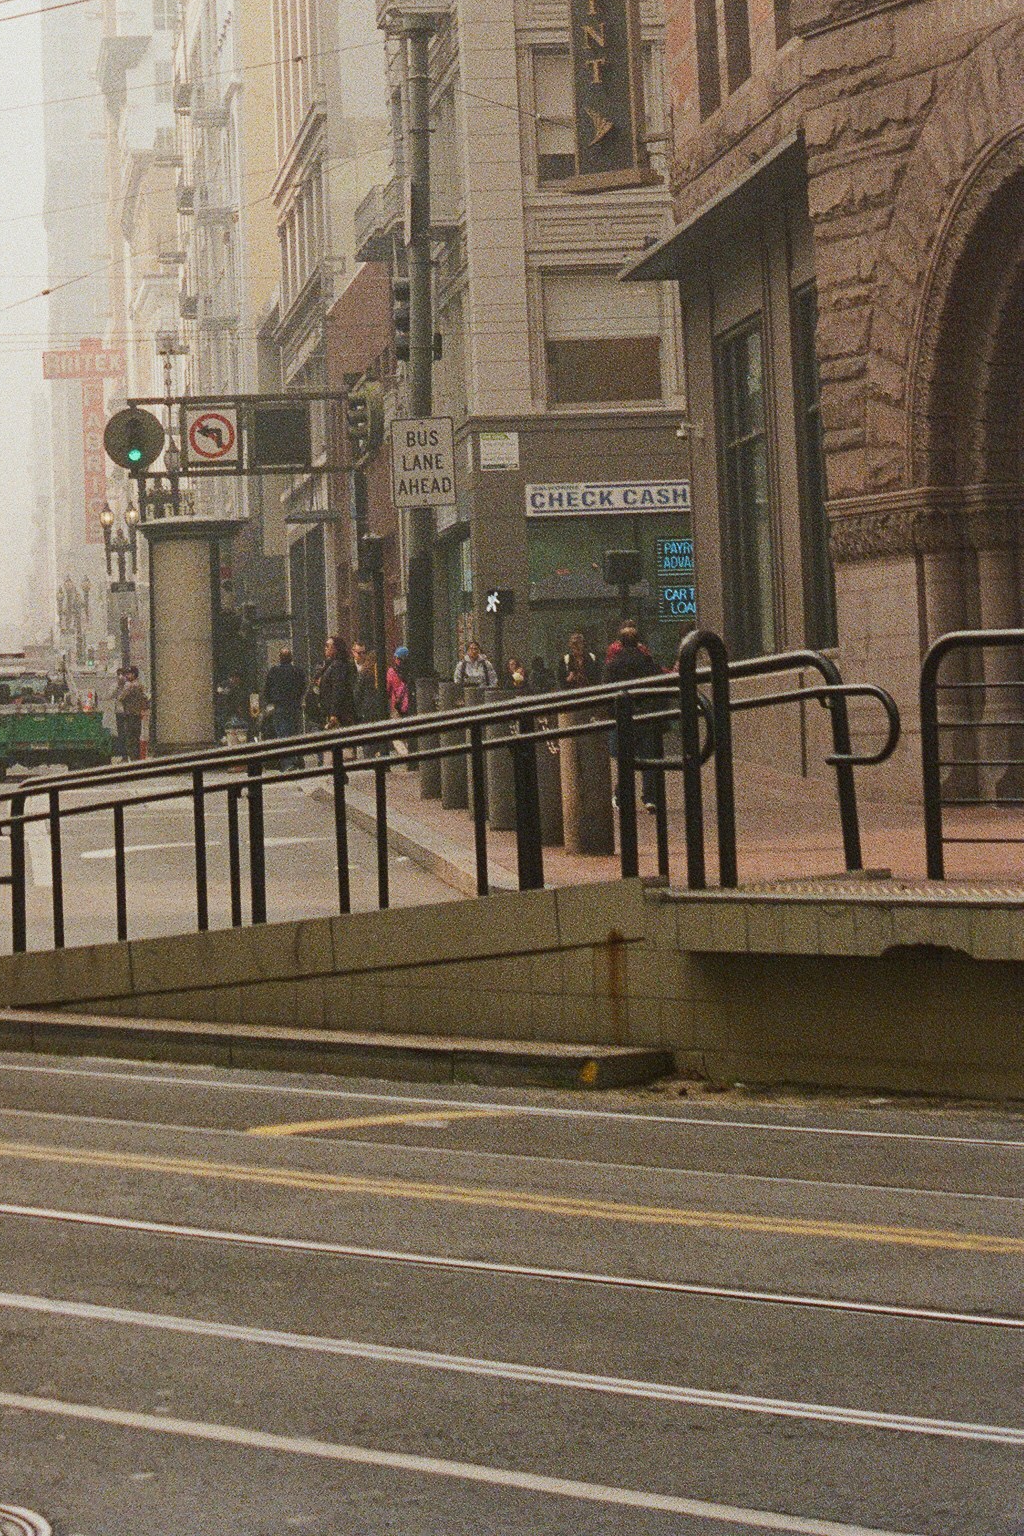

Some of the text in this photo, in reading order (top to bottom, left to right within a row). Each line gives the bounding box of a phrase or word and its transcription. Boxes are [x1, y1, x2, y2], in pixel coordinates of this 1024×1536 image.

[406, 430, 439, 447] BUS
[402, 453, 444, 471] LANE
[399, 476, 452, 495] AHEAD
[530, 487, 688, 509] CHECK CASH
[663, 555, 695, 569] ADVA
[664, 588, 688, 601] CAR
